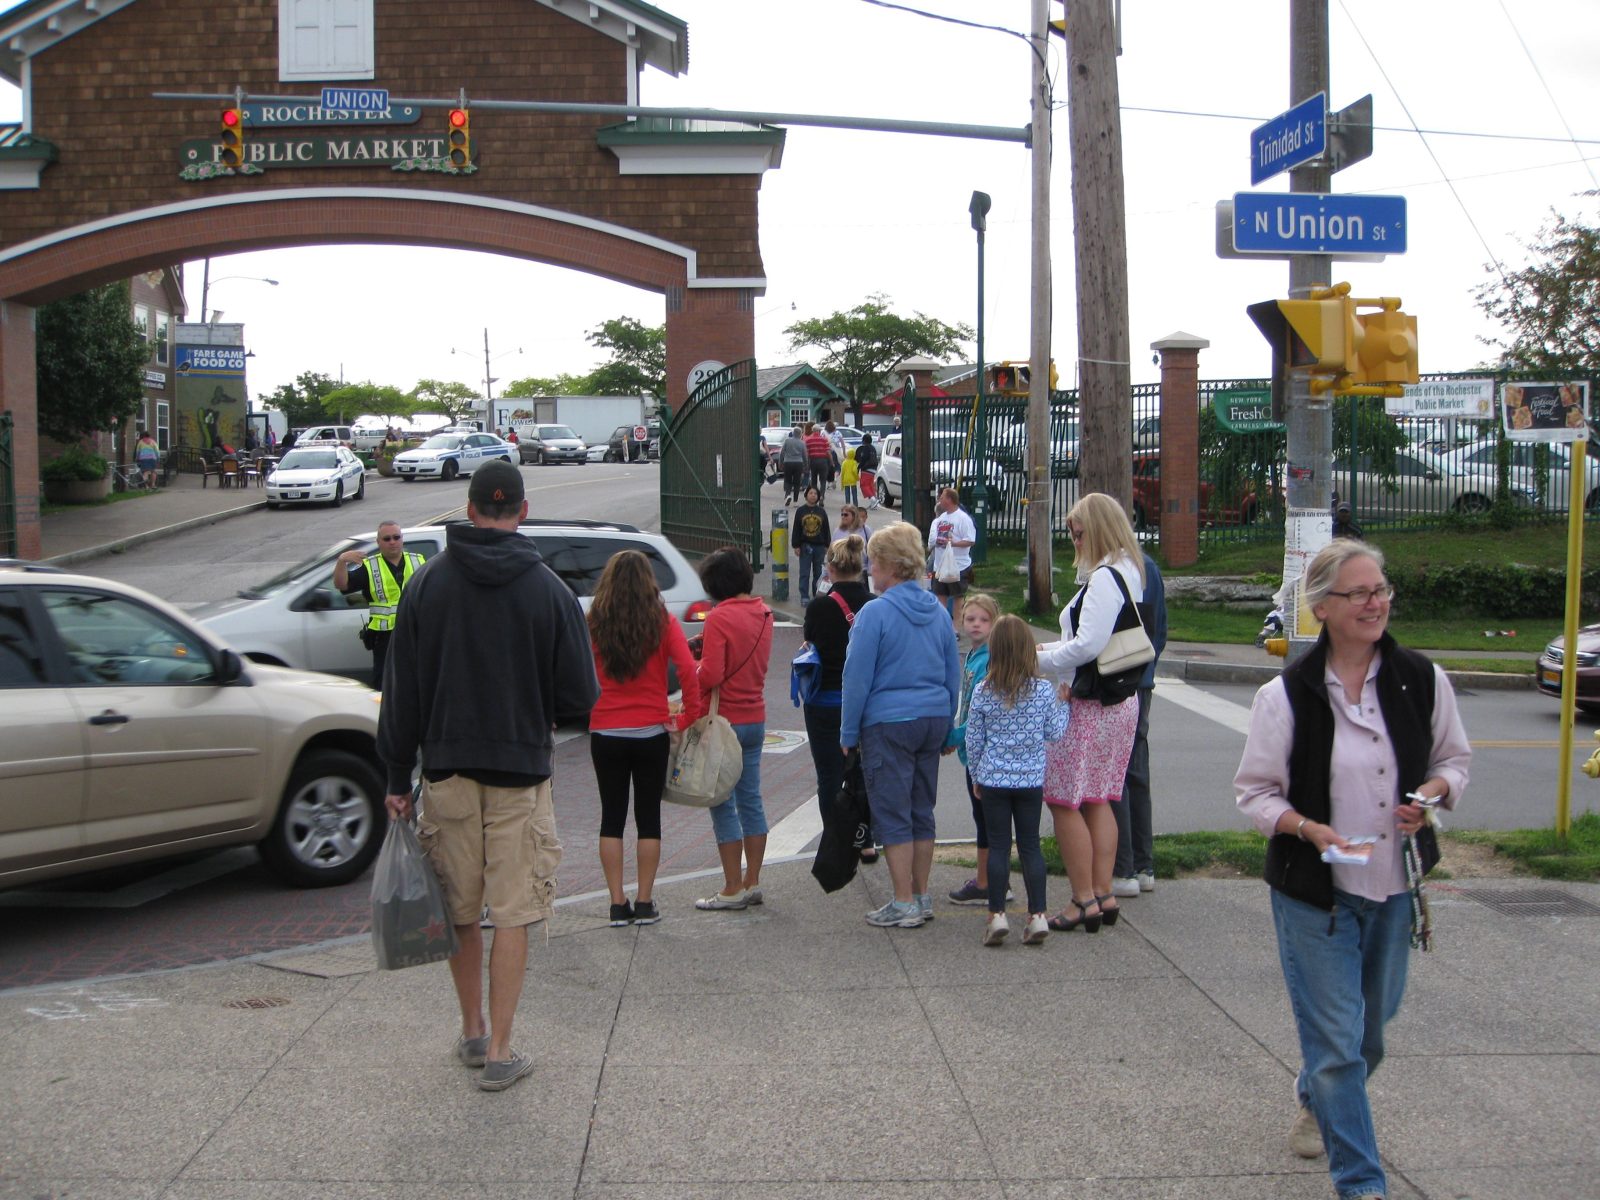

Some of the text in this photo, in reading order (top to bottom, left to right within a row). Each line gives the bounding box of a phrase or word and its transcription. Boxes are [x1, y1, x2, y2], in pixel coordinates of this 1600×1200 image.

[326, 91, 384, 109] UNION
[262, 106, 393, 121] ROCHESTER
[211, 139, 444, 163] PBLIC MARKET
[1259, 120, 1314, 168] Trinidad St
[1255, 207, 1386, 241] N Union St
[193, 350, 244, 359] FARE GAME
[193, 358, 244, 369] FOOD CO
[1424, 386, 1432, 396] of
[1433, 385, 1445, 396] the
[1446, 384, 1482, 395] Rochester
[1415, 399, 1464, 410] Public Market
[373, 569, 384, 600] POLICE
